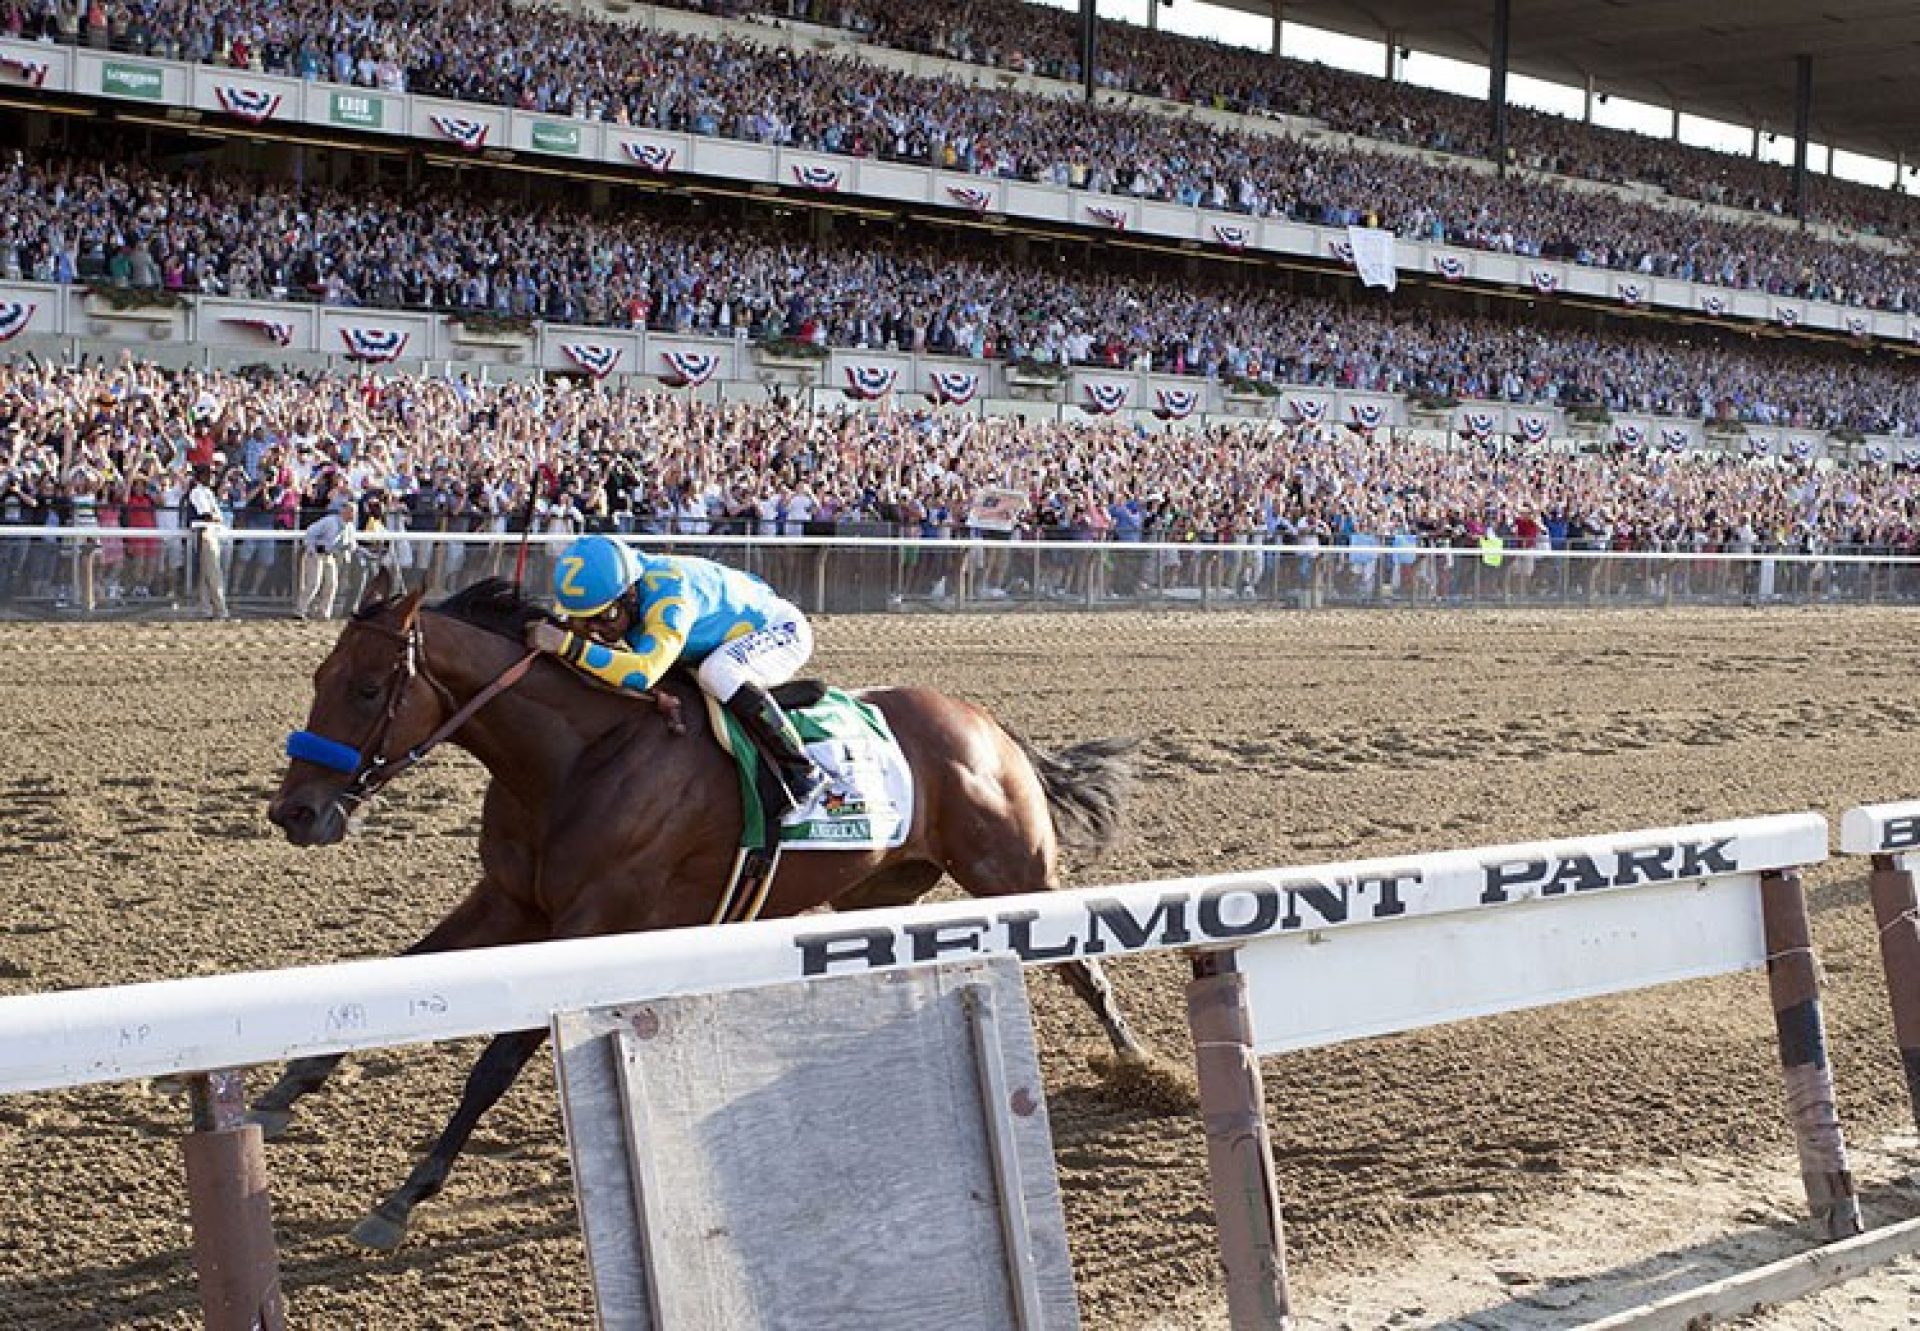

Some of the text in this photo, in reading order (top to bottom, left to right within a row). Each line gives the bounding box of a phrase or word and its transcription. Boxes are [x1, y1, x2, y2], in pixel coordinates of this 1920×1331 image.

[562, 557, 585, 596] Z
[794, 835, 1739, 976] BELMONT PARK
